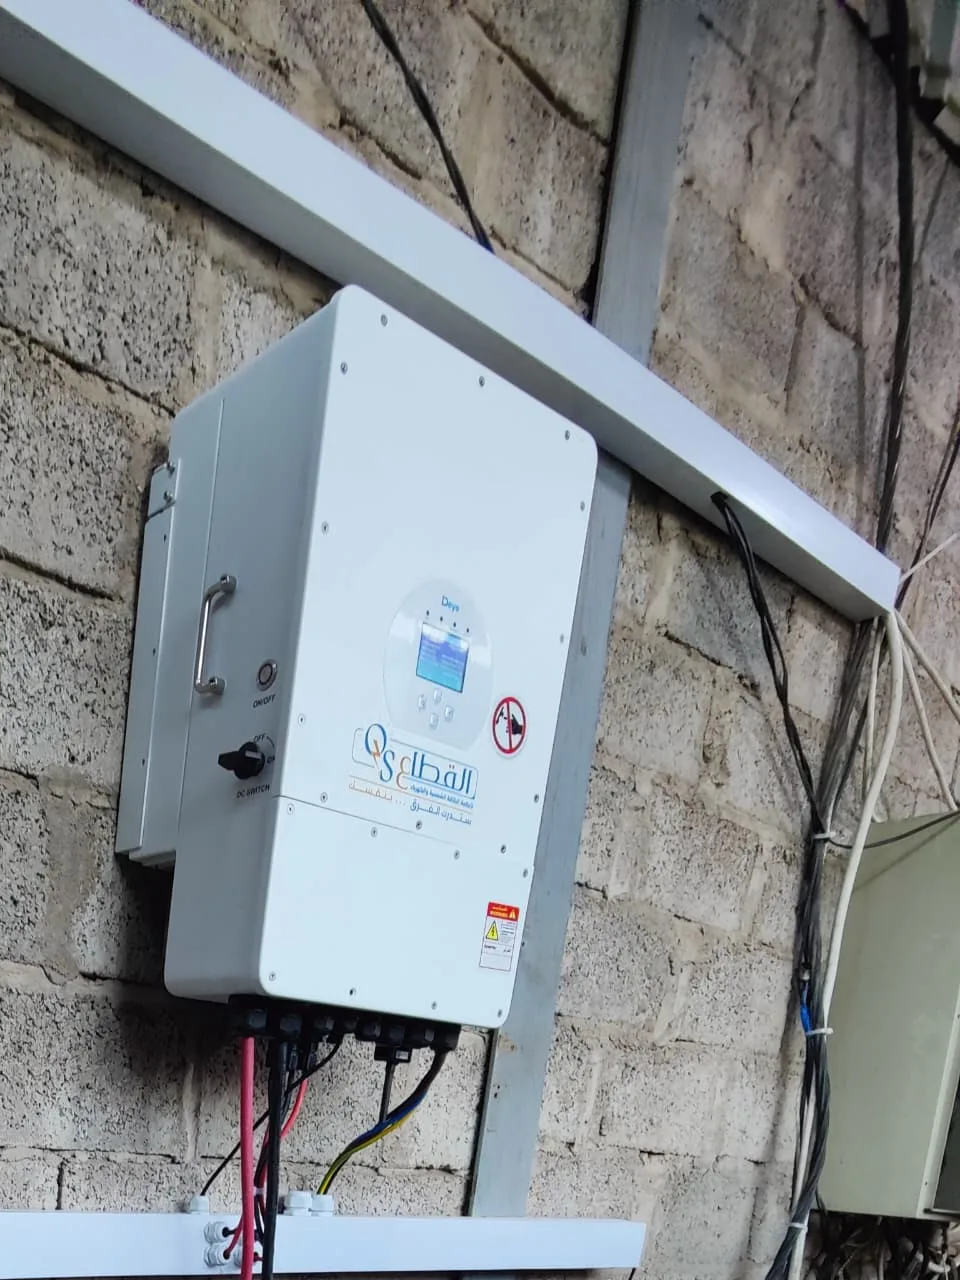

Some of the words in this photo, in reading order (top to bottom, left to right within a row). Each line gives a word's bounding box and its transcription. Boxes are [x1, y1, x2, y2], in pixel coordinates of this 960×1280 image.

[252, 694, 276, 708] ON/OFF
[253, 733, 266, 743] OFF
[246, 784, 270, 796] SWITCH
